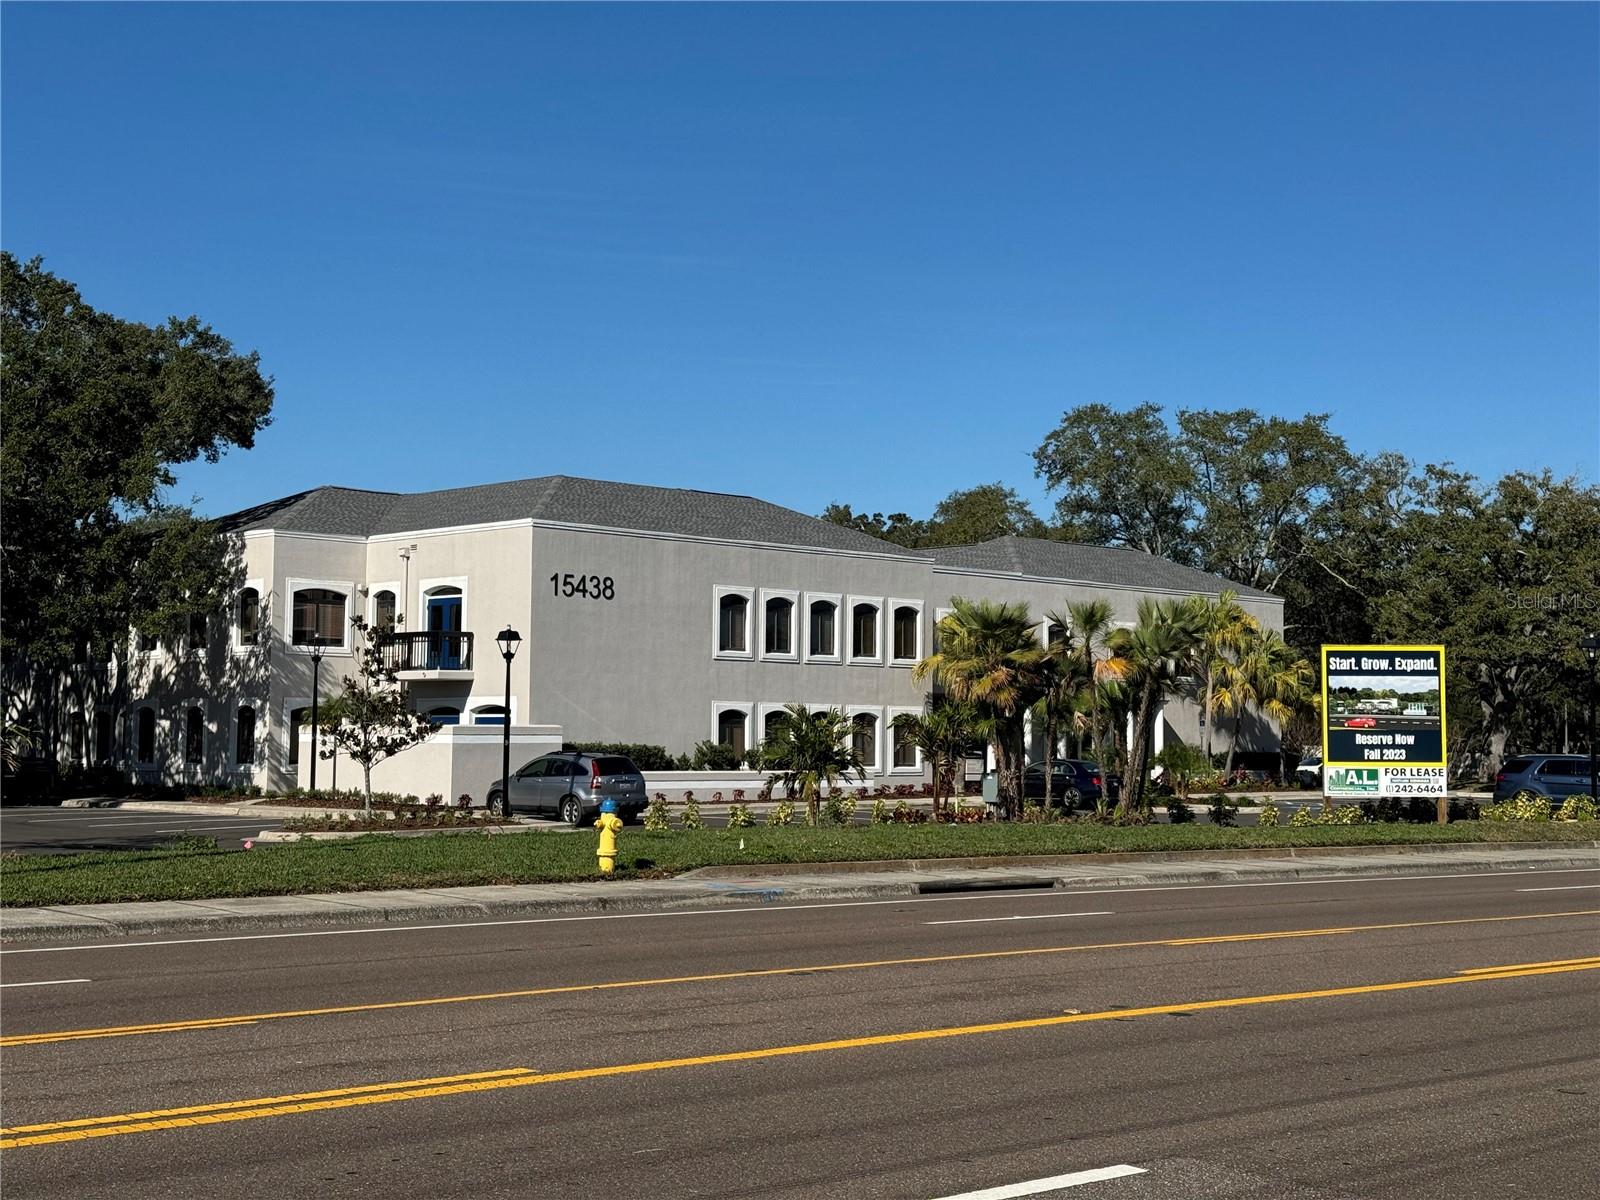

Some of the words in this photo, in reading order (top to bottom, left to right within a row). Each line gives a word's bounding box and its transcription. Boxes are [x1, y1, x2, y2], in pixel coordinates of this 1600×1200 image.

[550, 572, 615, 600] 15438
[1329, 657, 1359, 670] Start.
[1361, 657, 1392, 670] Grow.
[1395, 657, 1437, 672] Expand.
[1355, 733, 1392, 745] Reserve
[1395, 733, 1415, 745] Now
[1364, 749, 1380, 760] Fall
[1383, 749, 1406, 760] 2023
[1345, 770, 1378, 785] A.L.
[1384, 767, 1407, 777] FOR
[1410, 767, 1444, 777] LEASE
[1394, 784, 1443, 793] 242-6464
